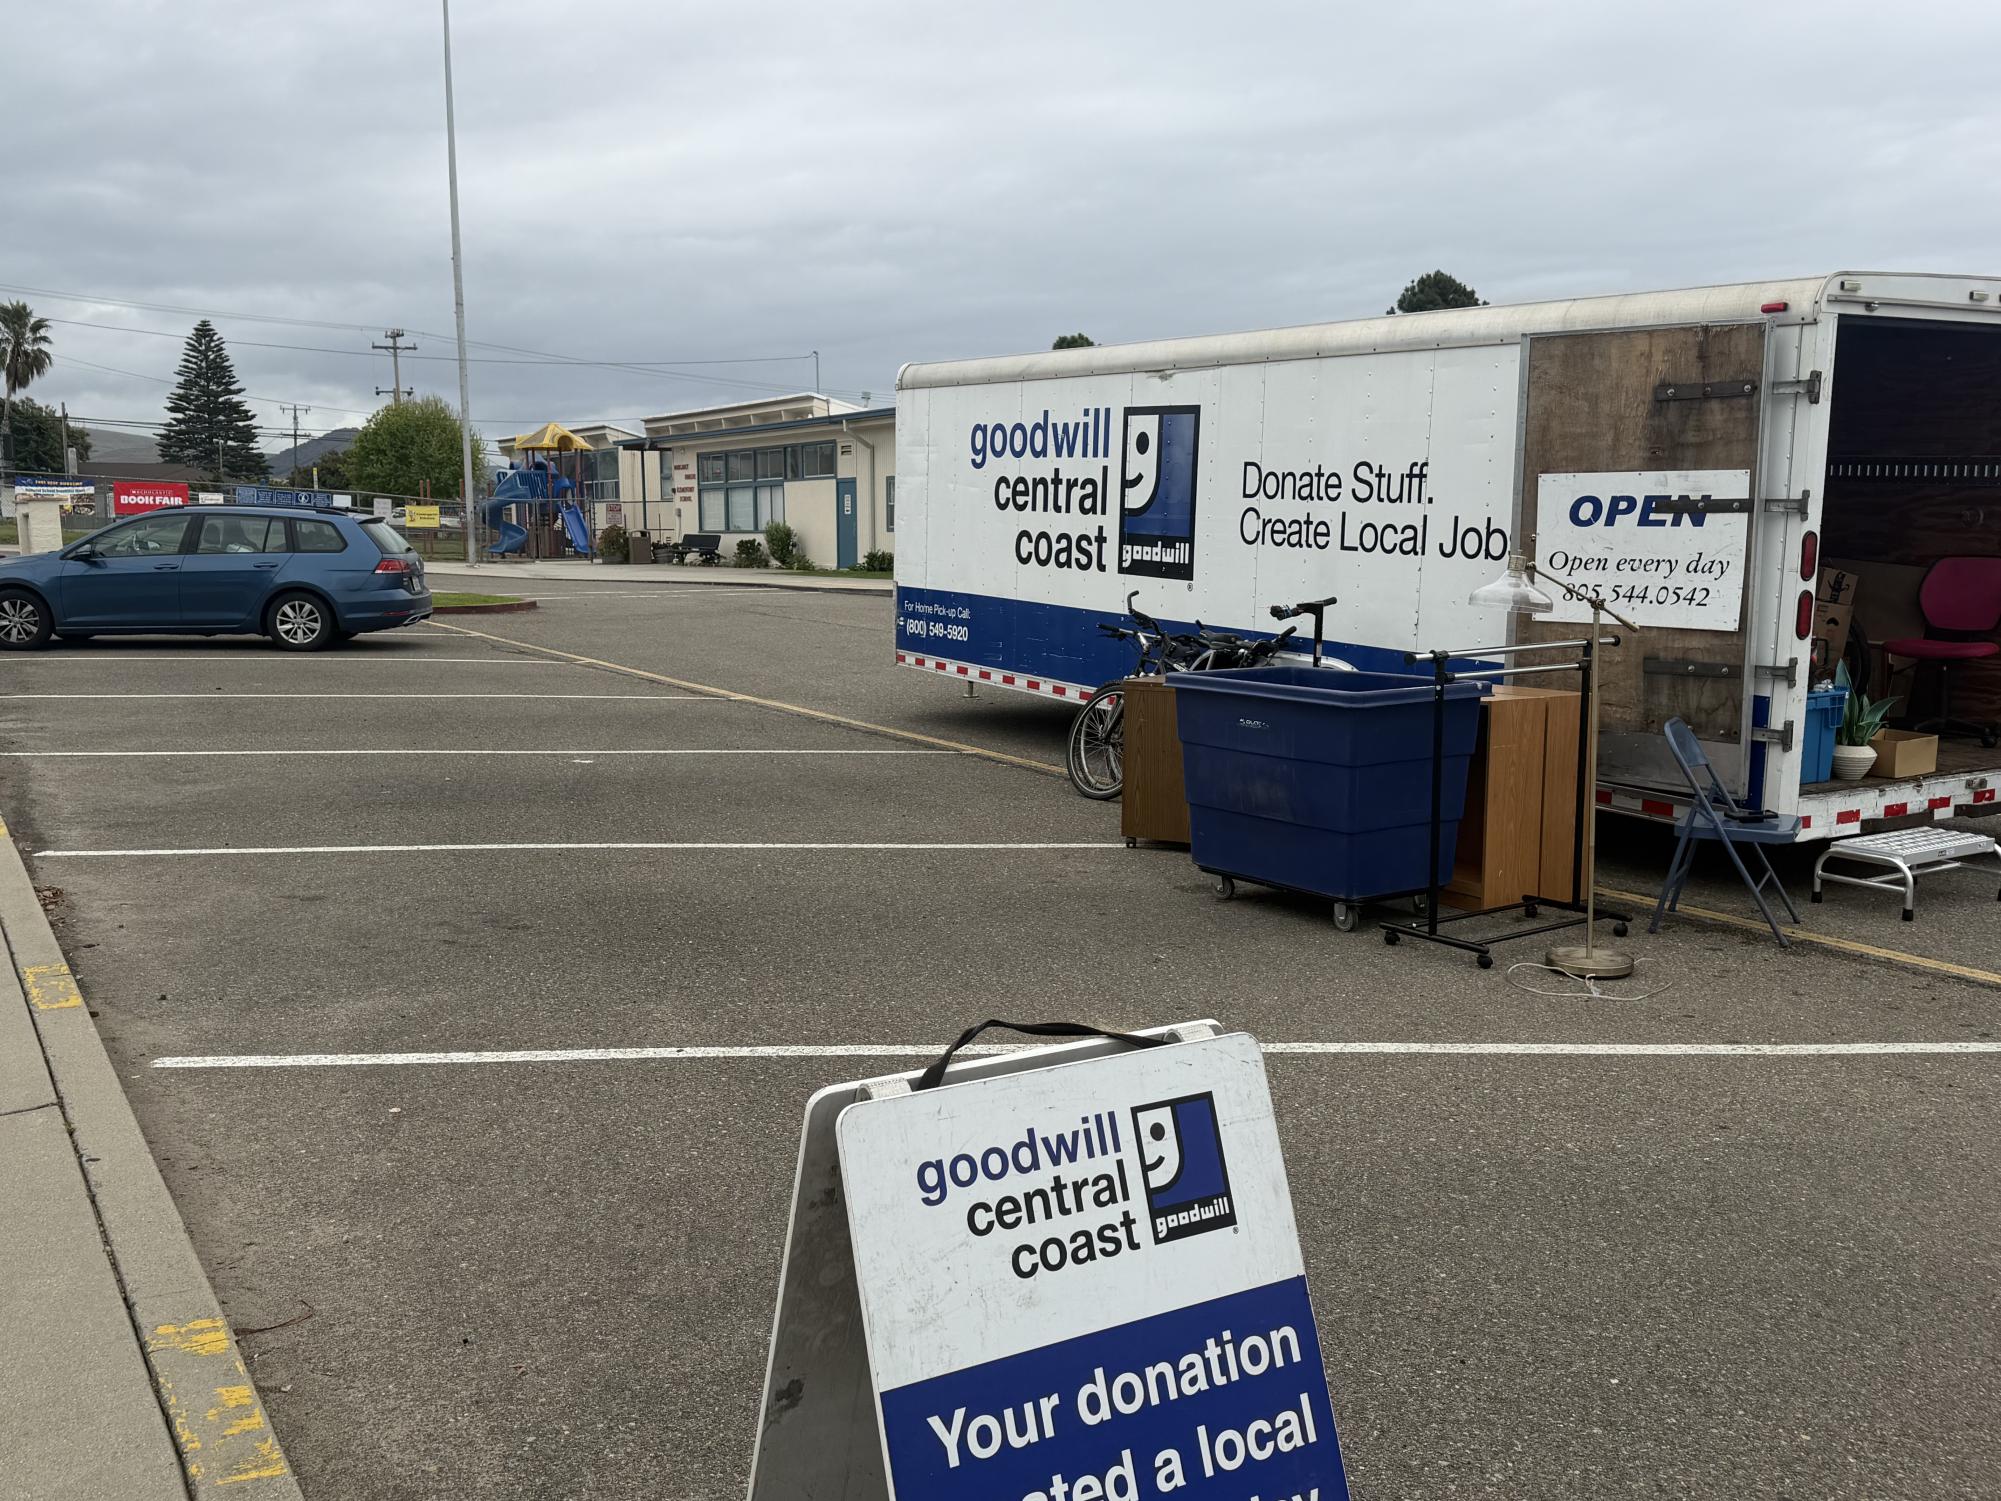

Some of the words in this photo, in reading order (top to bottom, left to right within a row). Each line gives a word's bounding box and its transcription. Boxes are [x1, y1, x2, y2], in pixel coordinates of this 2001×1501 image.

[970, 407, 1111, 469] goodwill
[120, 495, 154, 504] BOOK
[155, 496, 183, 505] FAIR
[994, 465, 1109, 516] central
[1242, 461, 1342, 502] Donate
[1351, 460, 1434, 504] Stuff.
[1239, 506, 1331, 550] Create
[1339, 511, 1428, 556] Local
[1438, 515, 1512, 561] Job
[1568, 494, 1712, 528] OPEN
[1015, 525, 1107, 573] coast
[1122, 541, 1190, 568] goodwill
[1549, 550, 1609, 577] Open
[1616, 557, 1679, 580] every
[1685, 552, 1730, 581] day
[904, 600, 914, 611] For
[915, 601, 933, 614] Home
[933, 603, 956, 619] Pick-up
[1562, 582, 1710, 607] 805544.0542
[906, 618, 927, 637] (800)
[929, 621, 969, 642] 549-5920
[916, 1110, 1122, 1207] goodwill
[966, 1158, 1131, 1237] central
[1155, 1197, 1230, 1239] goodwill
[1011, 1210, 1141, 1279] coast
[926, 1392, 1061, 1469] Your
[1076, 1325, 1302, 1426] donation
[1154, 1448, 1186, 1493] a
[1196, 1392, 1318, 1478] local
